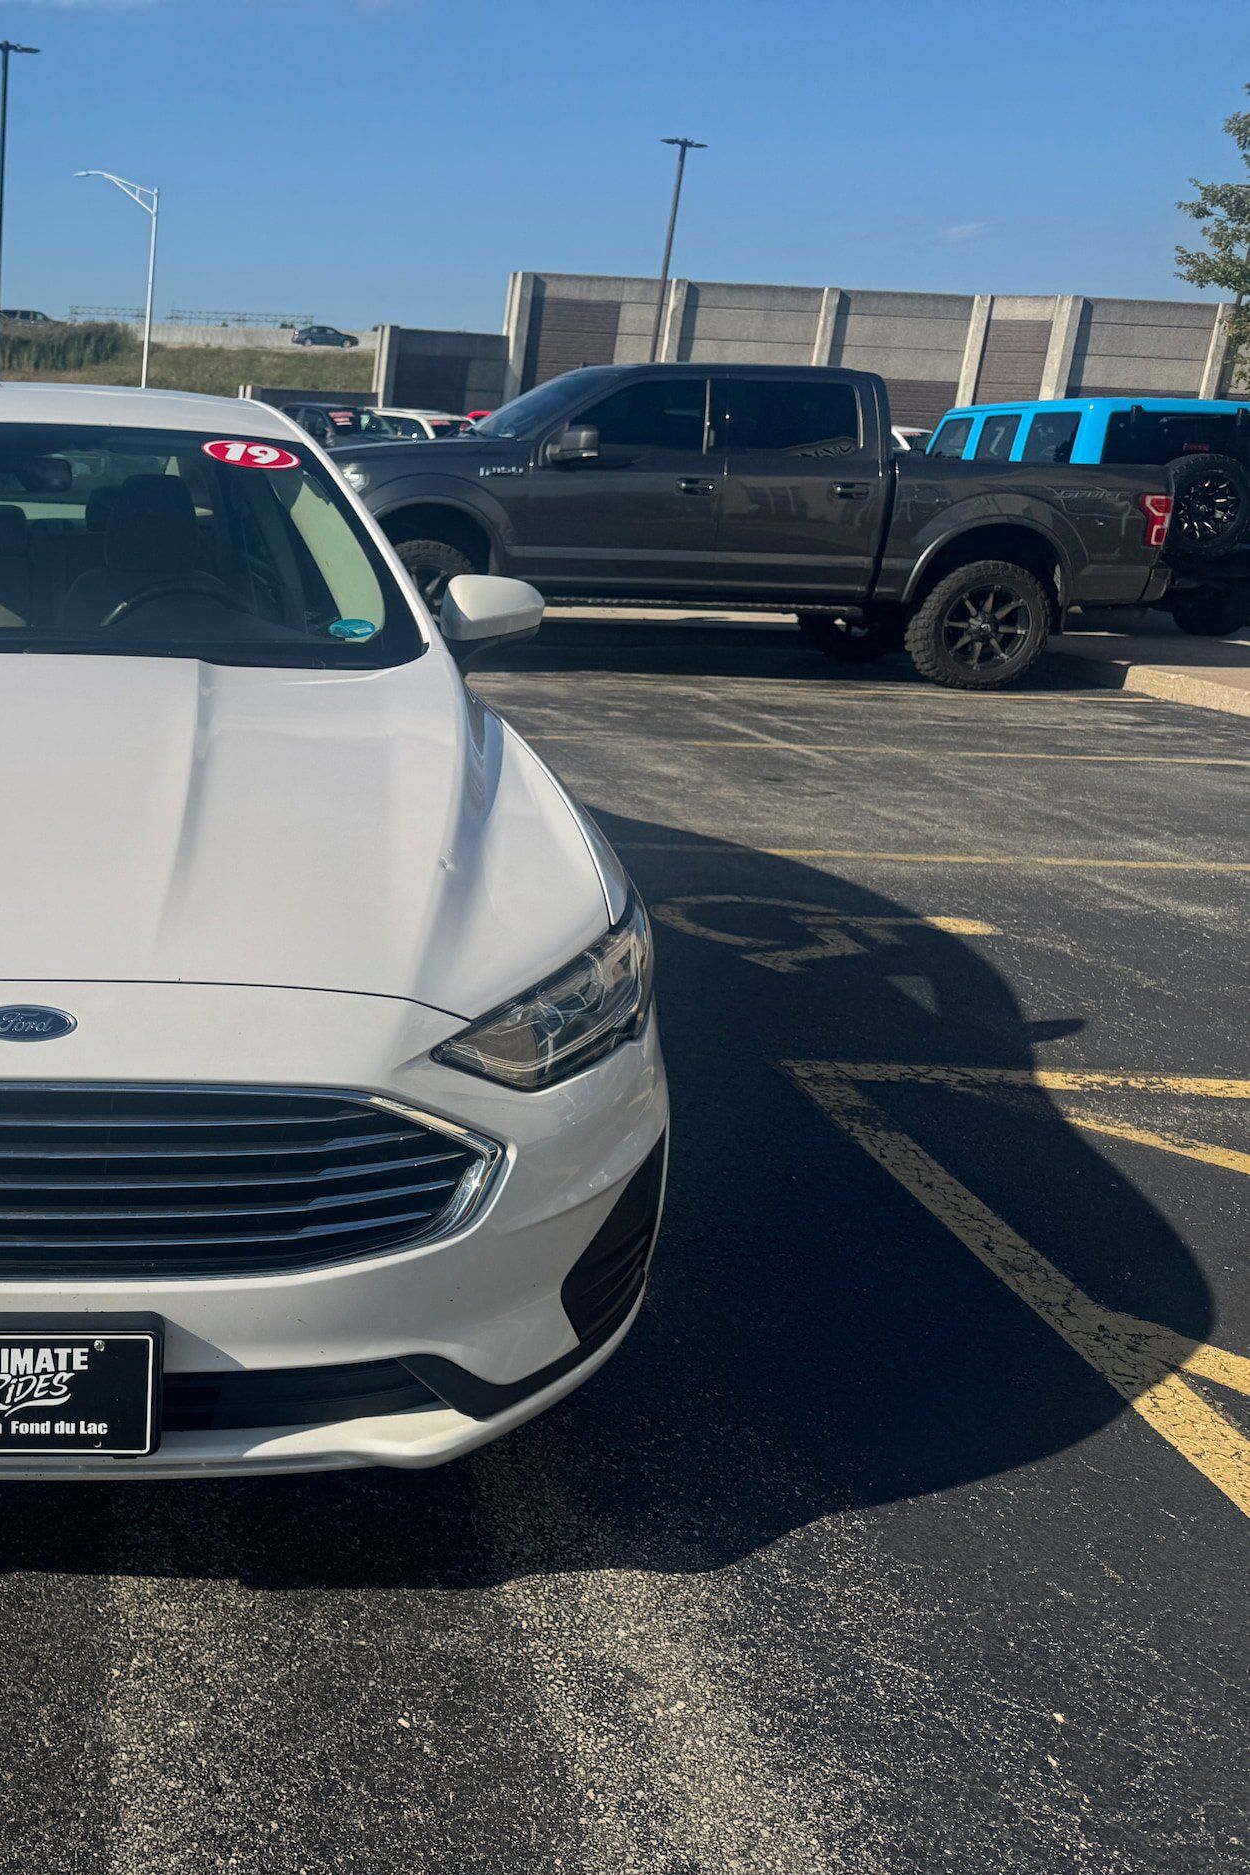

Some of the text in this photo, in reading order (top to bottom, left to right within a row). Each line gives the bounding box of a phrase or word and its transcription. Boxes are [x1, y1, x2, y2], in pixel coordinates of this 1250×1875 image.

[224, 443, 281, 465] 19
[10, 1420, 50, 1435] Fond
[54, 1420, 76, 1435] du
[79, 1420, 109, 1435] Lac
